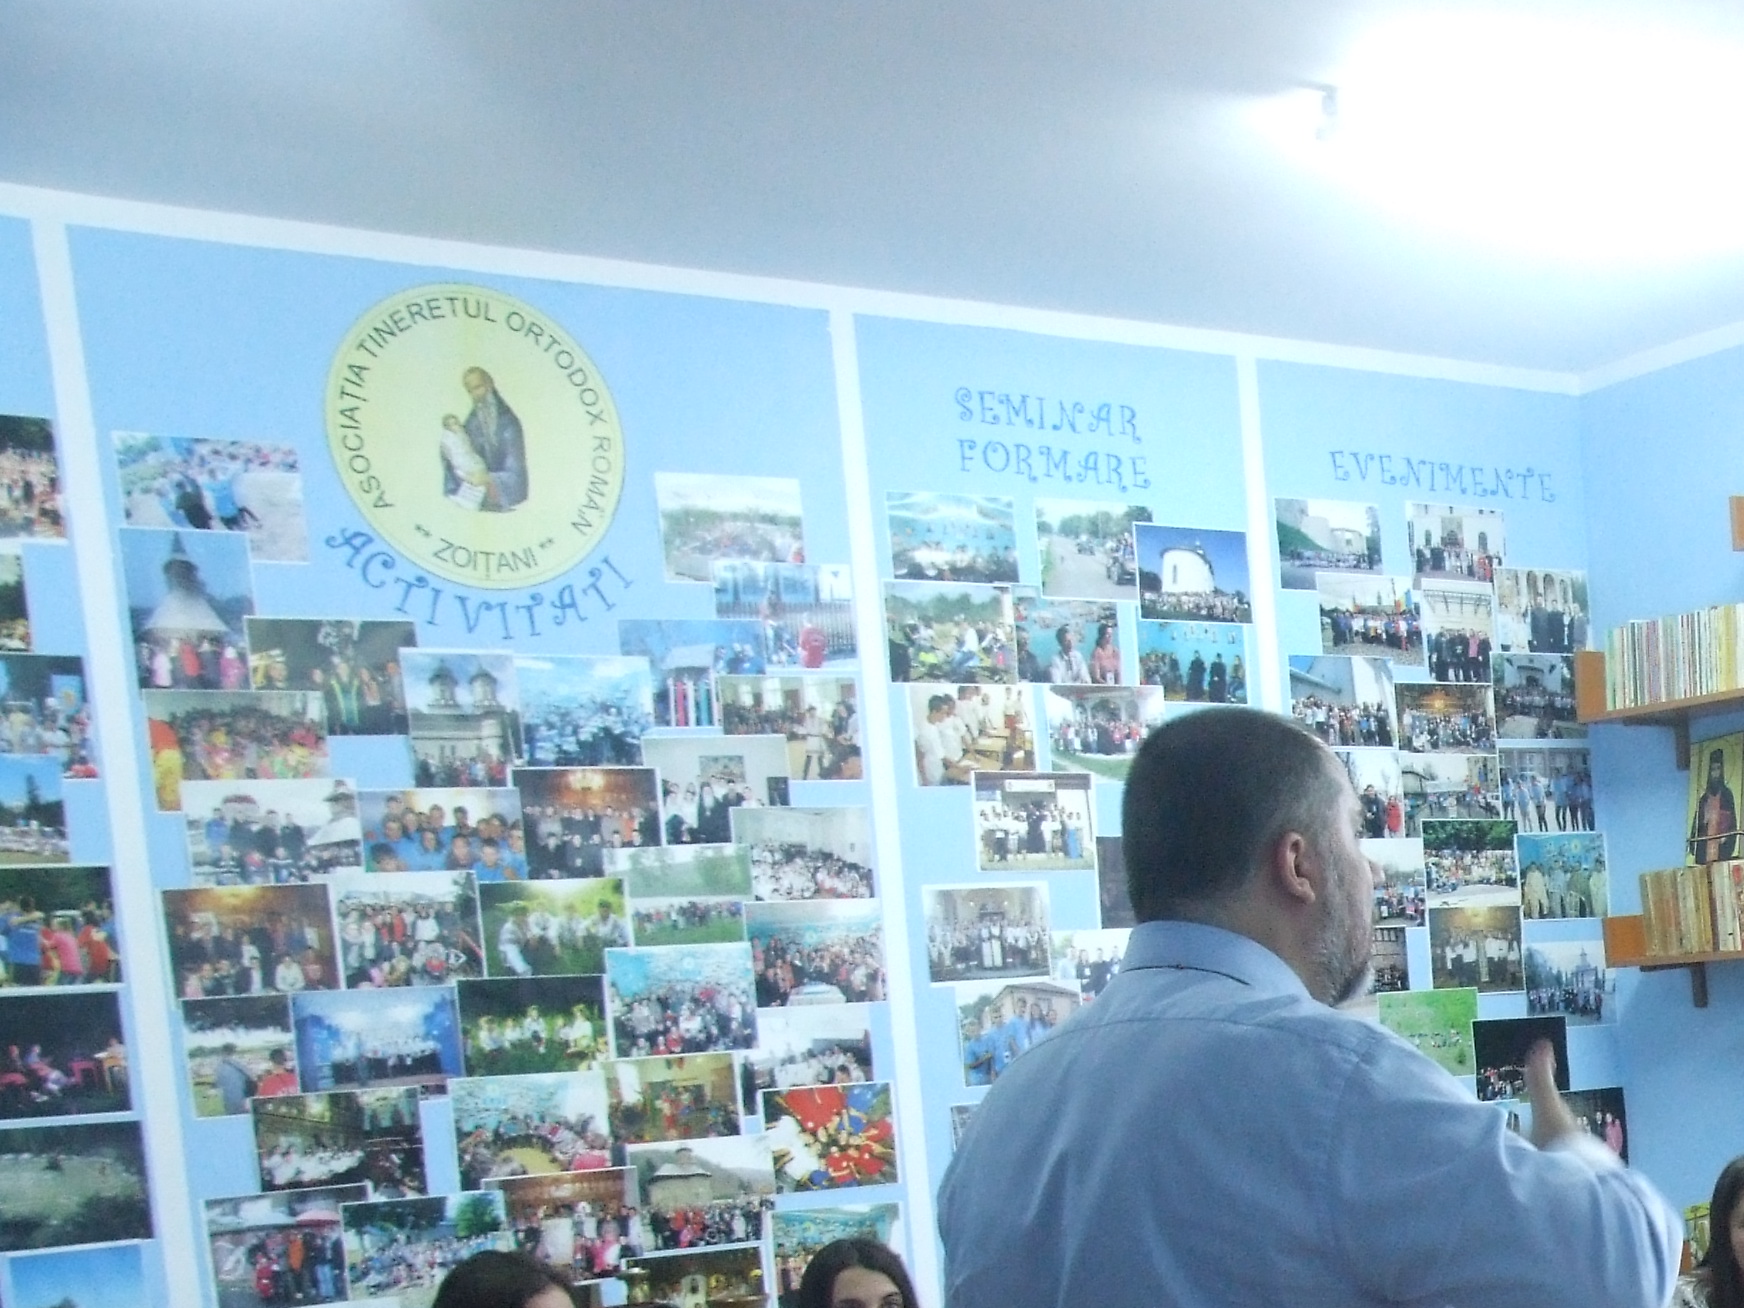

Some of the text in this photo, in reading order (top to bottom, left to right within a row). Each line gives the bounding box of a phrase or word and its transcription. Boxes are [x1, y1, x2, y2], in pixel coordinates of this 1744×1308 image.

[356, 297, 497, 358] TINERETUL
[504, 311, 609, 425] ORTODOX
[954, 386, 1143, 444] SEMINAR
[956, 438, 1152, 493] FORMARE
[1329, 450, 1557, 503] EVENIMENTE
